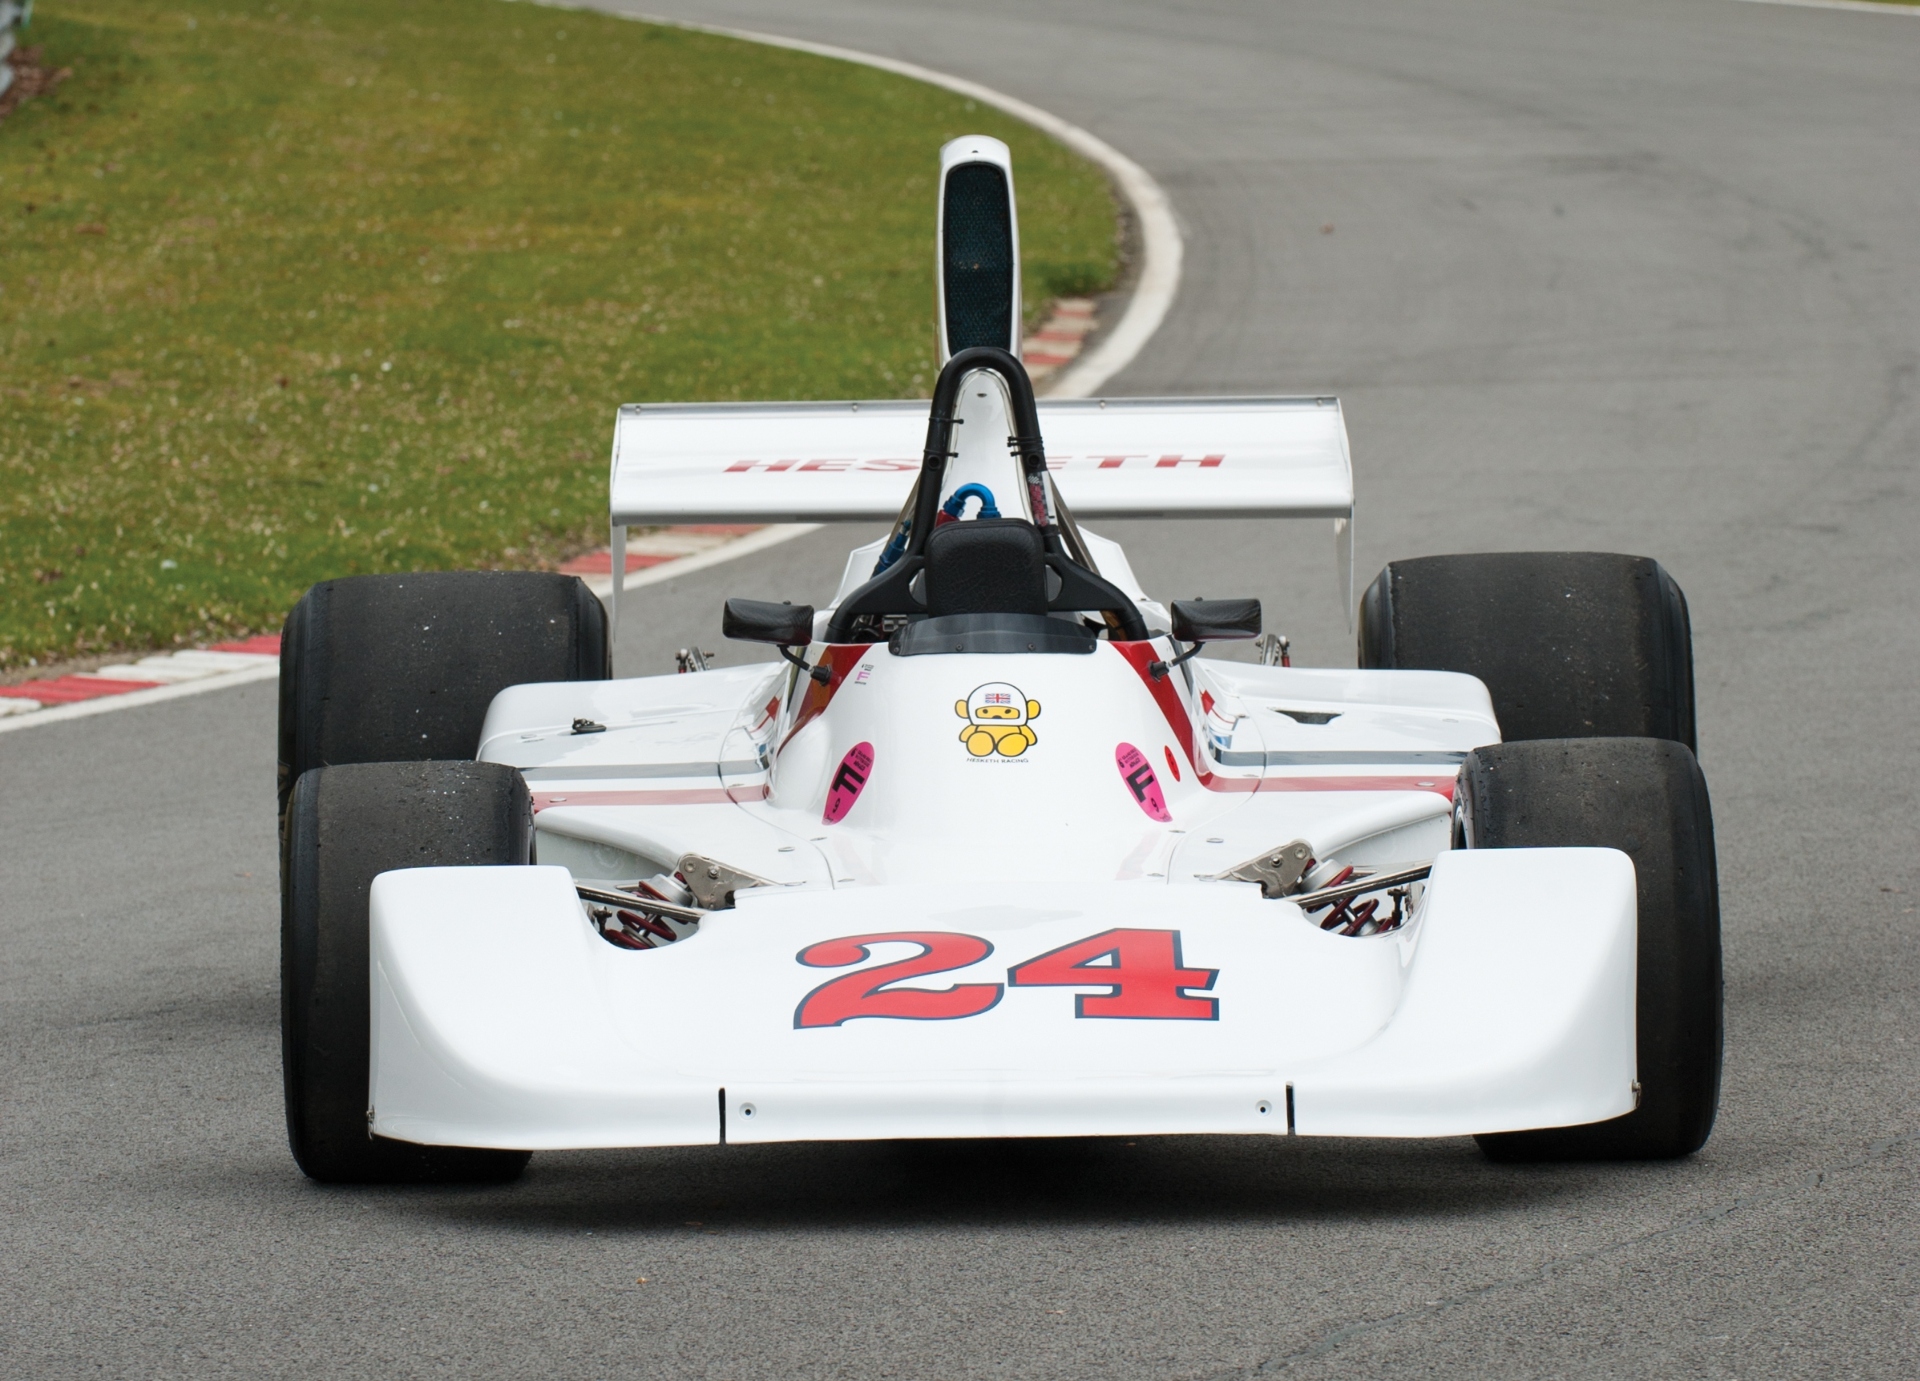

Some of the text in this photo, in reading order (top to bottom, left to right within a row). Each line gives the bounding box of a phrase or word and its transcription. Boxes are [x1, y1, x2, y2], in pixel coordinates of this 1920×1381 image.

[723, 454, 1226, 473] HESETH
[832, 762, 865, 795] F
[1126, 763, 1154, 803] F
[793, 927, 1221, 1030] 24
